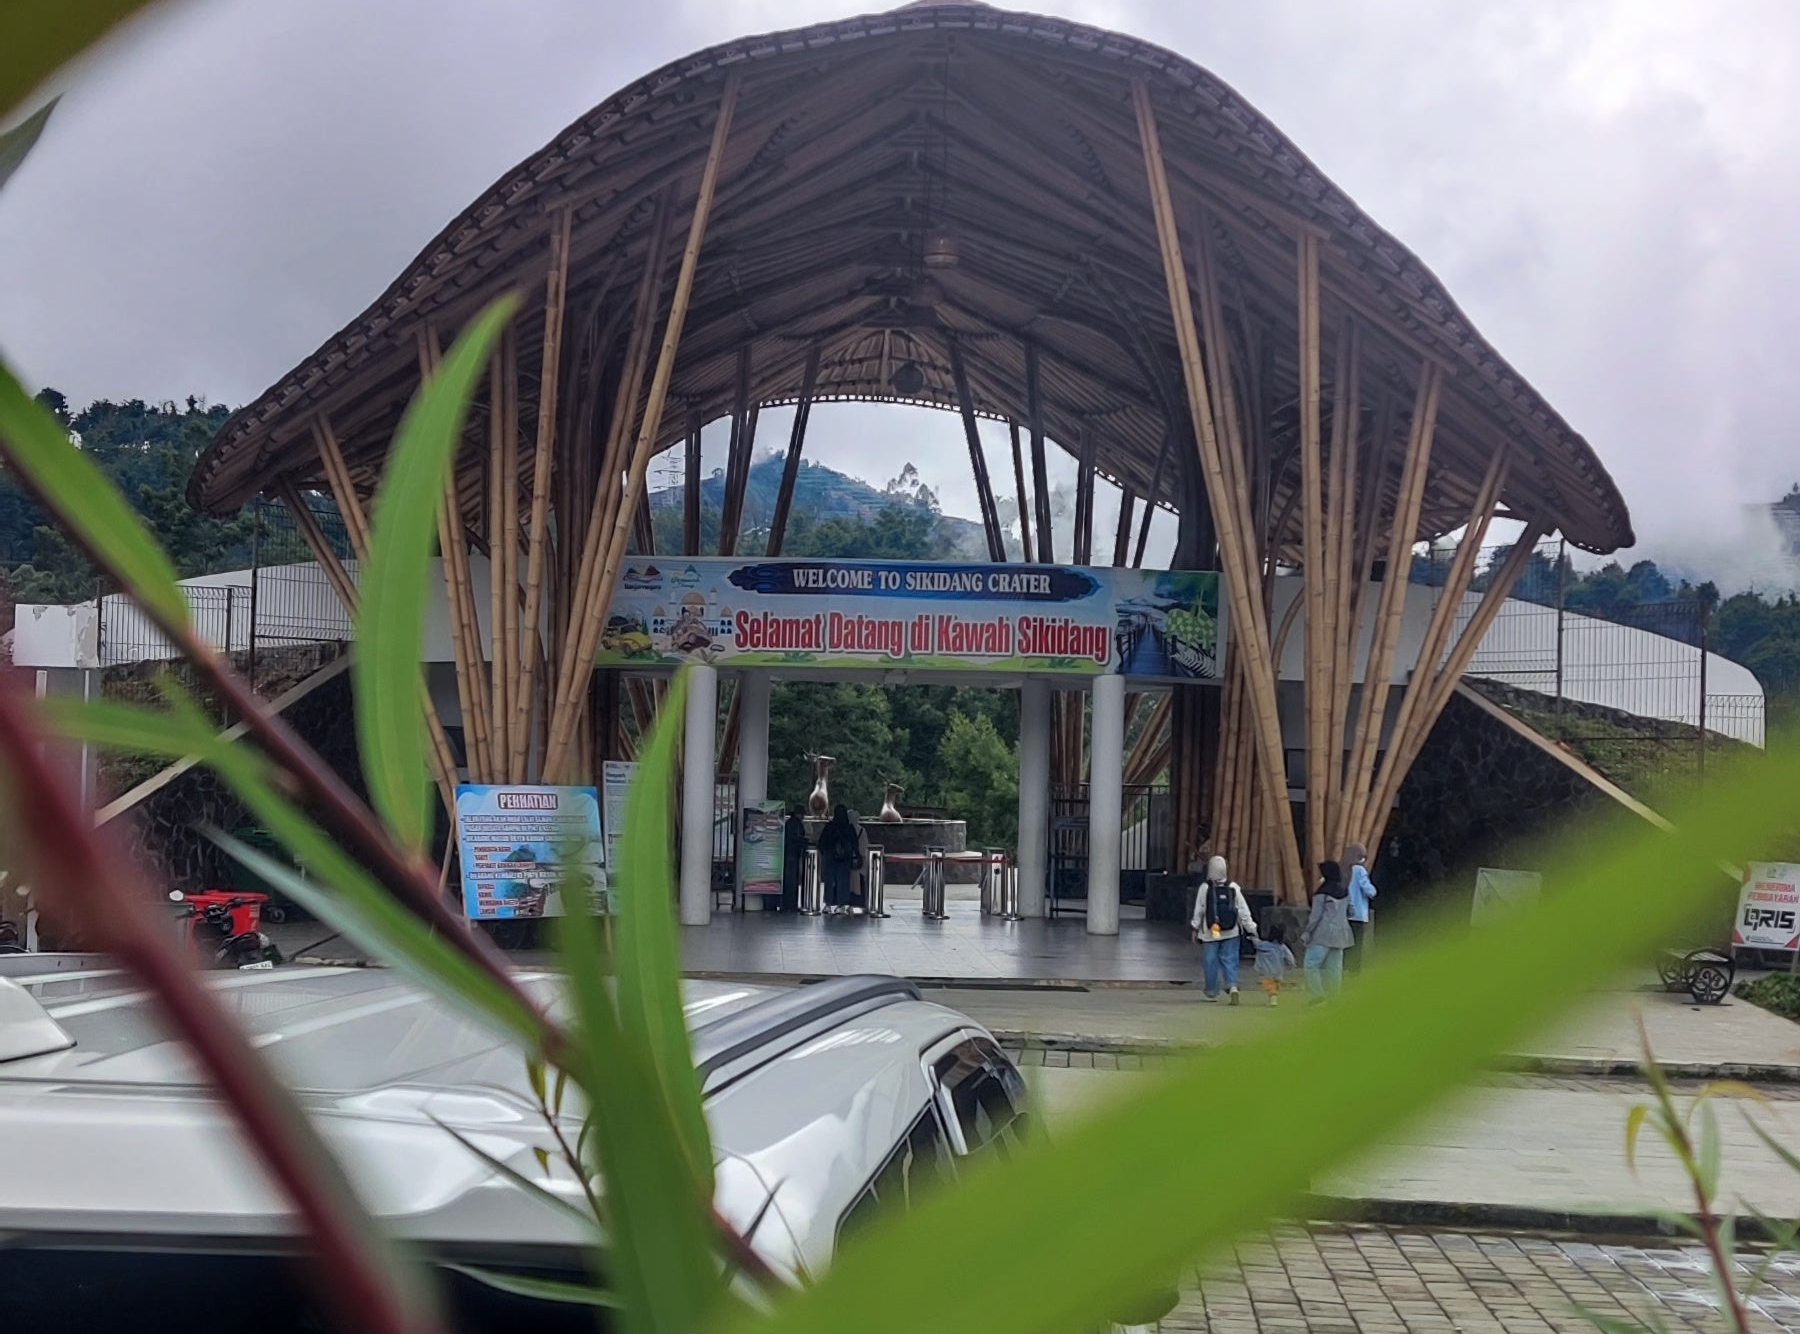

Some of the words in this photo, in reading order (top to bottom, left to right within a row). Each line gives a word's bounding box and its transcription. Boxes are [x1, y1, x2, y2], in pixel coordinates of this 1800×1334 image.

[793, 568, 873, 589] WELCOME
[878, 570, 901, 590] TO
[905, 572, 983, 592] SIKIDANG
[988, 574, 1051, 594] CRATER
[735, 610, 822, 649] Selamat
[829, 612, 903, 657] Datang
[911, 614, 930, 652] di
[937, 615, 1011, 653] Kawah
[1018, 616, 1108, 662] Sikidang
[1743, 907, 1796, 931] QRIS
